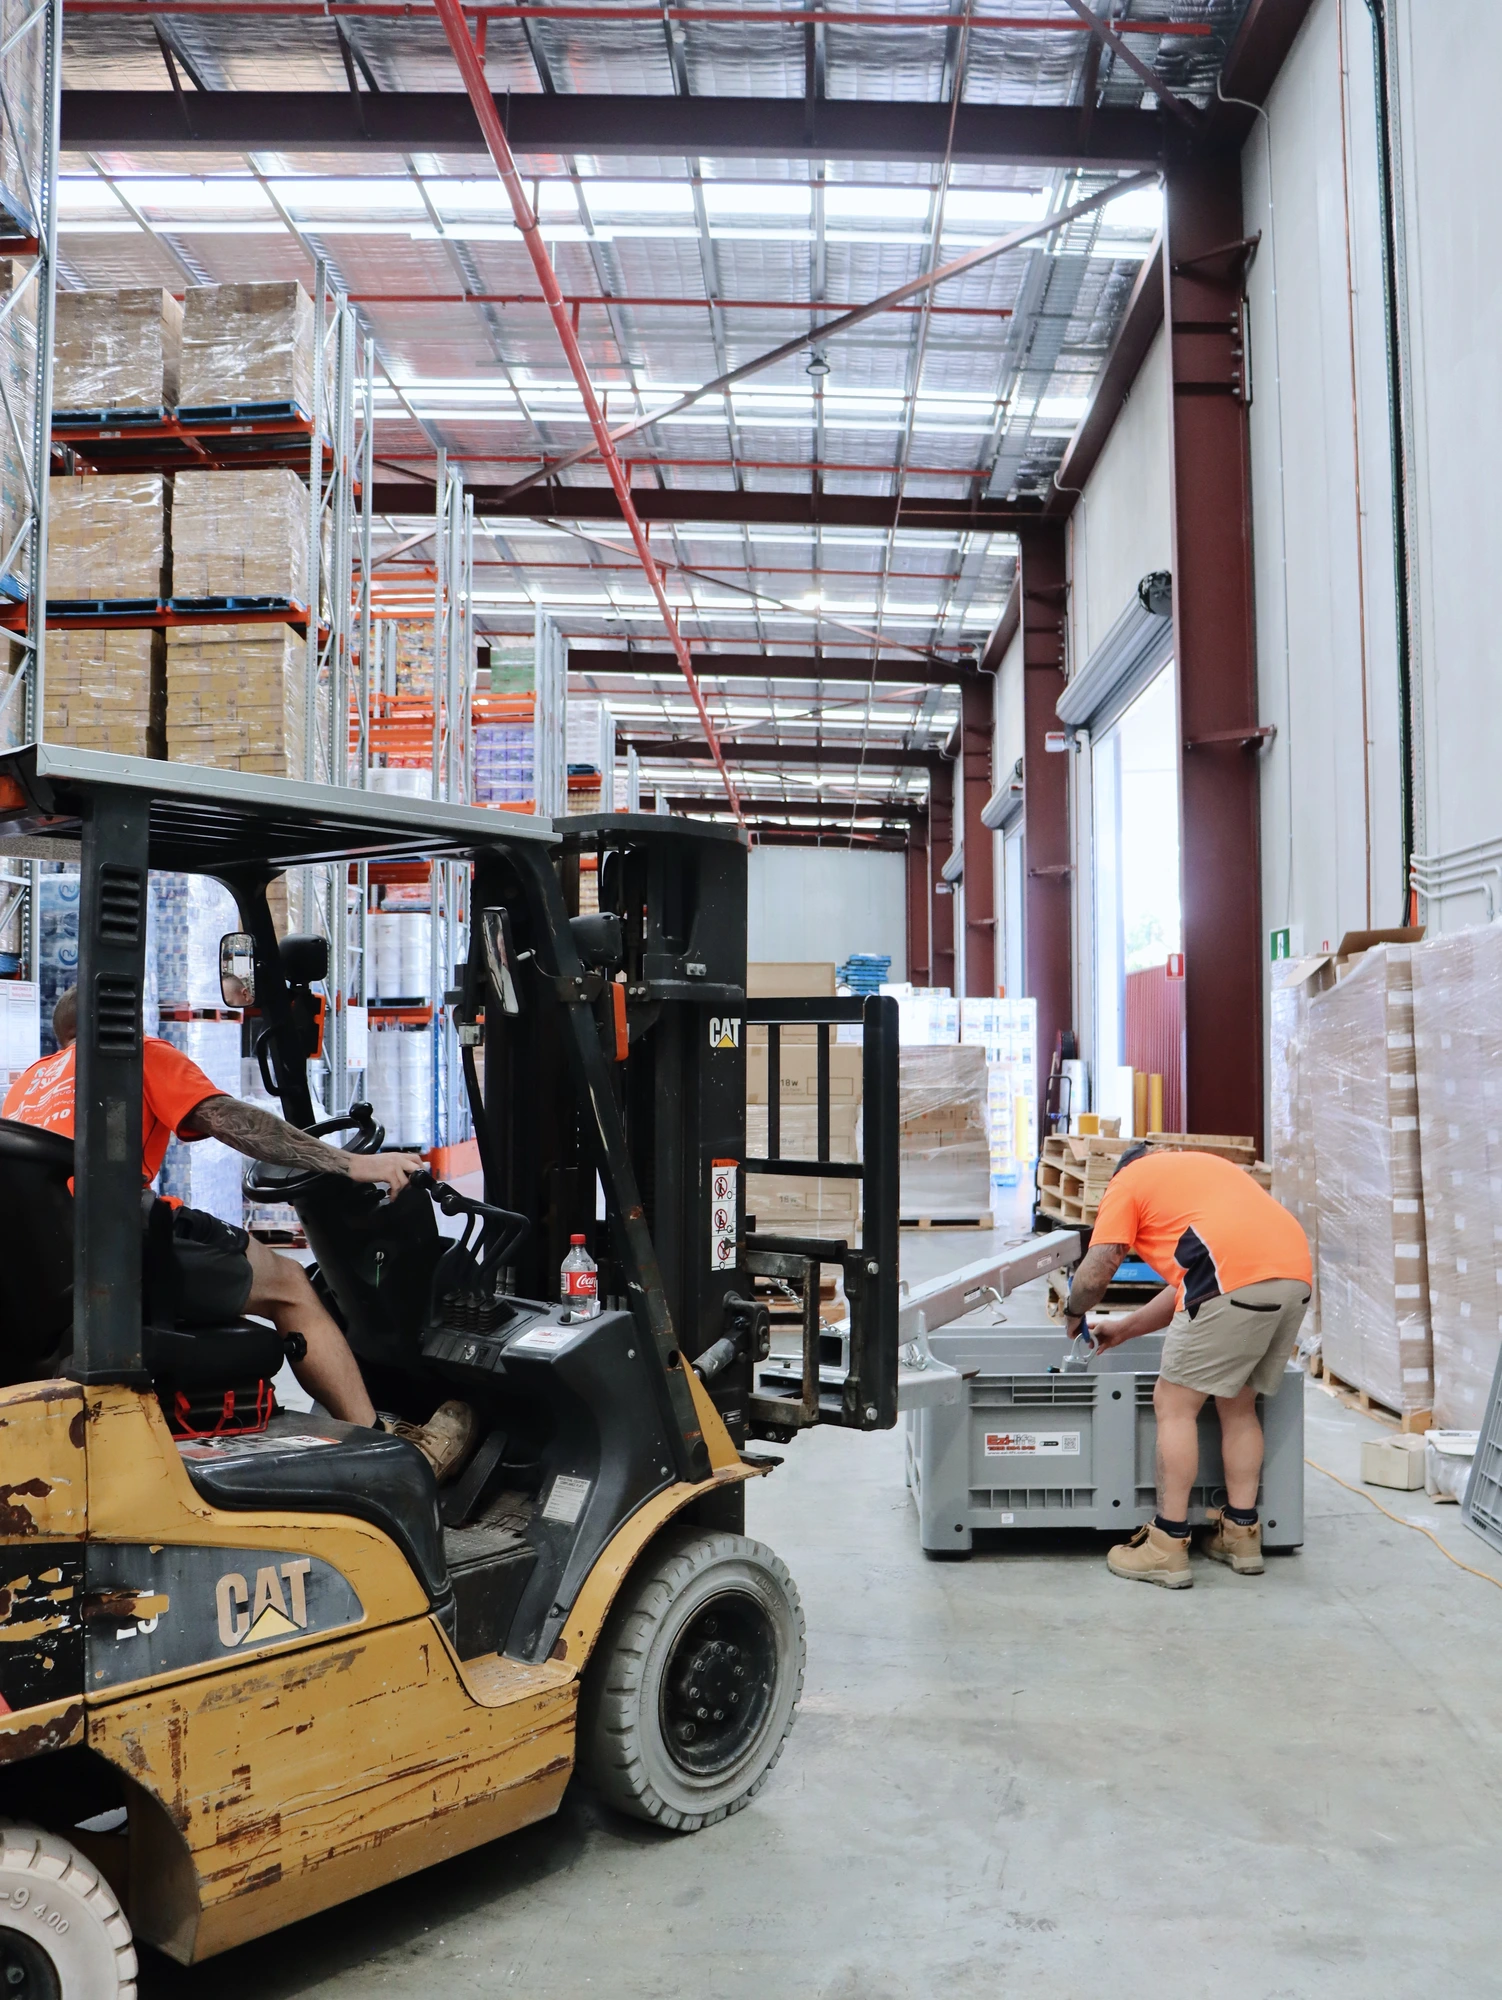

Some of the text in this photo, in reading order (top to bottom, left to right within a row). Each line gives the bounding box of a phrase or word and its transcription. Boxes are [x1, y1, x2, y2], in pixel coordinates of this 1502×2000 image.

[709, 1017, 741, 1048] CAT
[216, 1558, 311, 1648] CAT
[33, 1903, 70, 1935] 4.00
